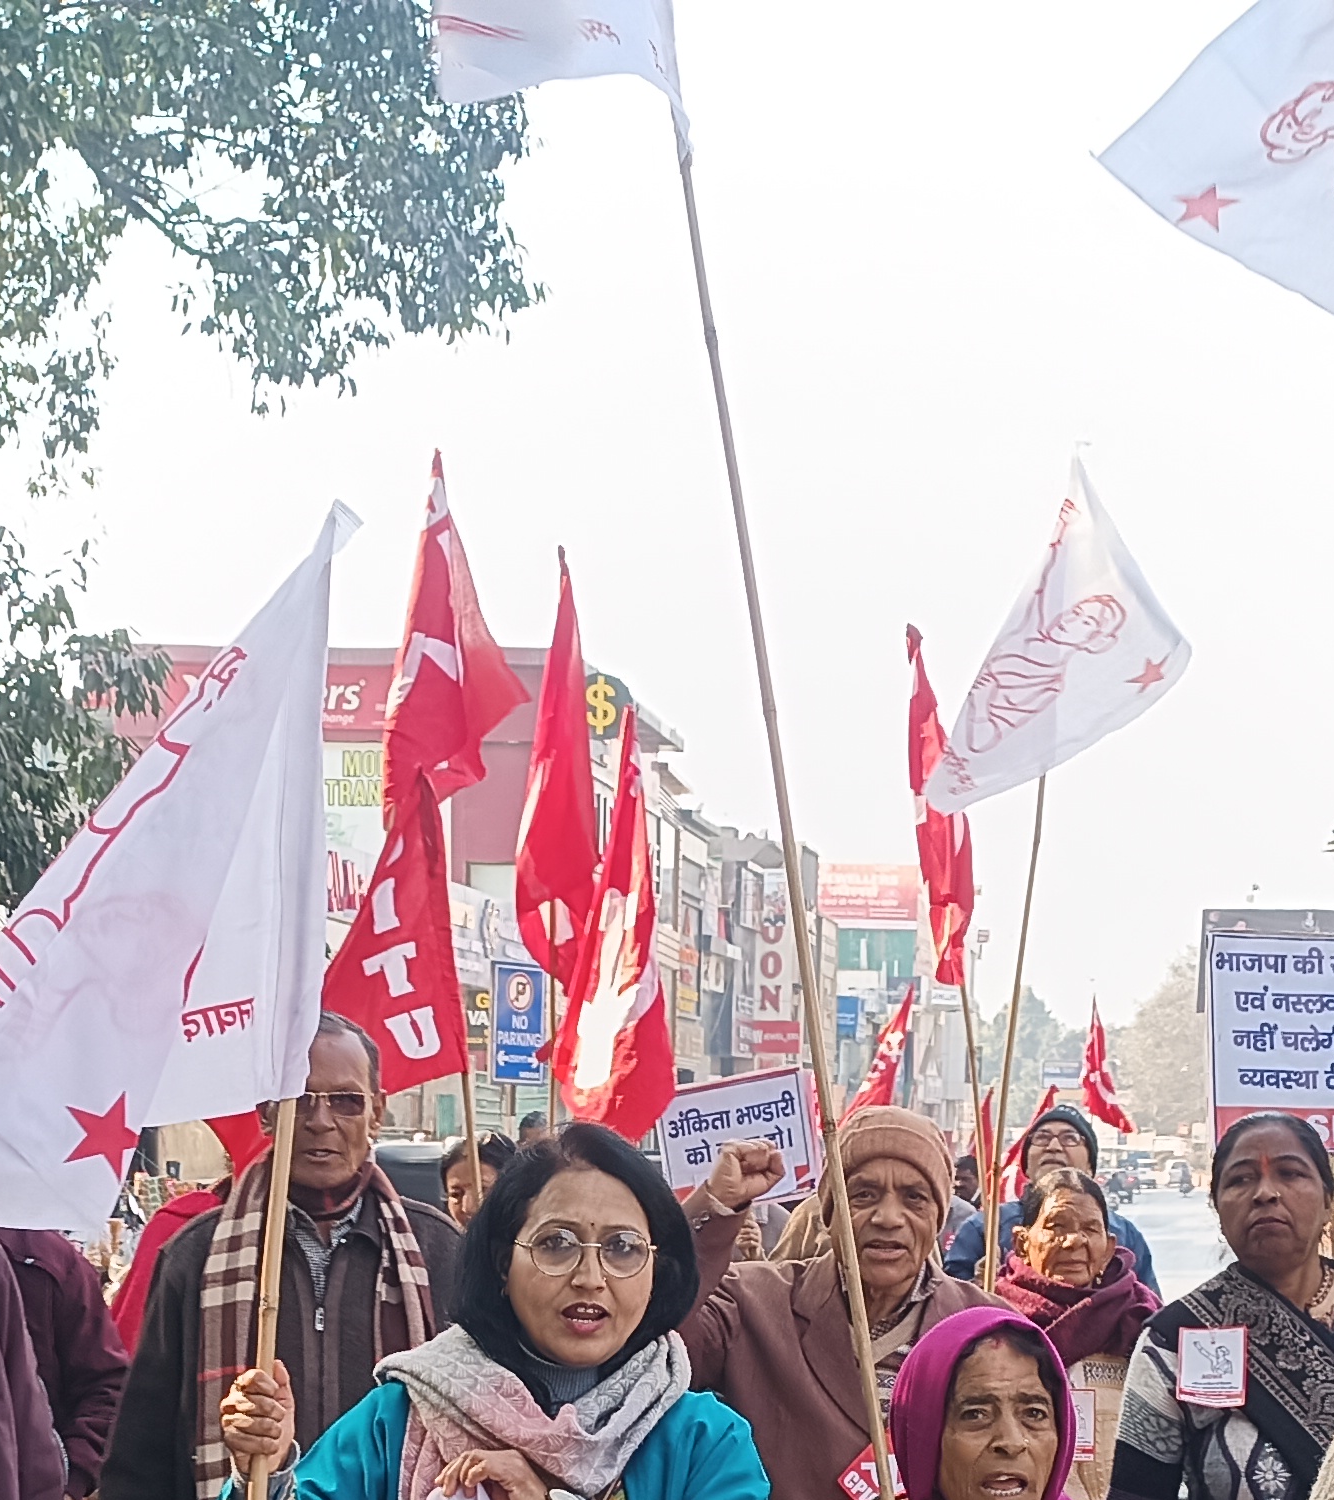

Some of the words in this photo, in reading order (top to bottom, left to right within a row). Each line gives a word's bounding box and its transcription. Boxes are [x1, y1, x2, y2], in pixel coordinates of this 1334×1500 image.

[325, 778, 383, 807] TRAN
[1215, 951, 1286, 974] भाजपा
[1293, 947, 1324, 975] की
[1235, 986, 1270, 1013] एवं
[512, 1015, 528, 1029] NO
[497, 1031, 542, 1048] PARKING
[1233, 1022, 1278, 1052] नहीं
[1239, 1069, 1318, 1091] व्यवस्था
[668, 1108, 730, 1139] अंकिता
[736, 1090, 795, 1125] भण्डारी
[685, 1139, 712, 1165] को
